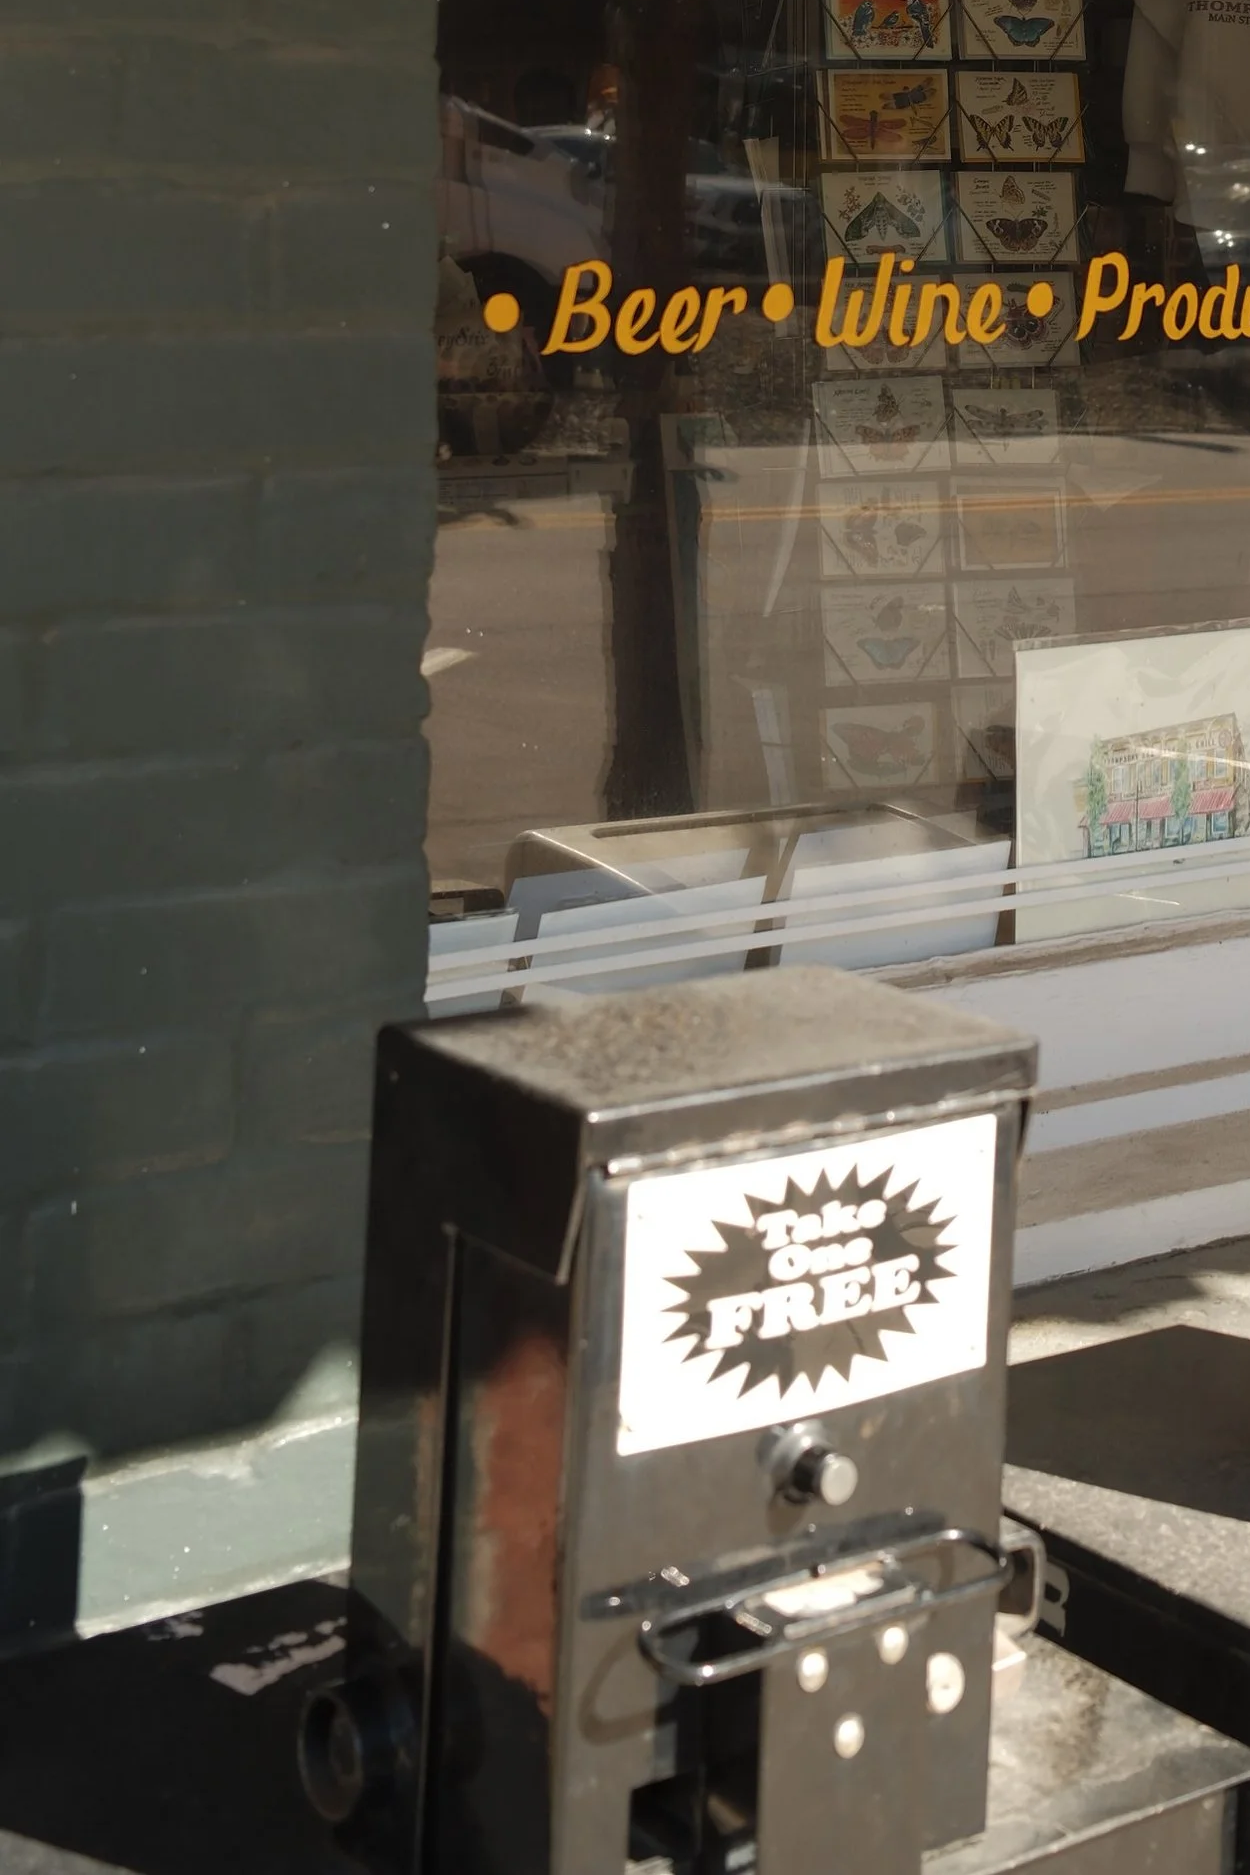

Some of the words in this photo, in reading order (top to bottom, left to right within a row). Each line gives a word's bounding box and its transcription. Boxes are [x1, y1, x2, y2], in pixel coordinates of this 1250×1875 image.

[541, 259, 748, 356] Beer
[814, 252, 1007, 349] Wine
[757, 1199, 887, 1250] Take
[768, 1237, 874, 1281] One
[705, 1253, 922, 1350] FREE
